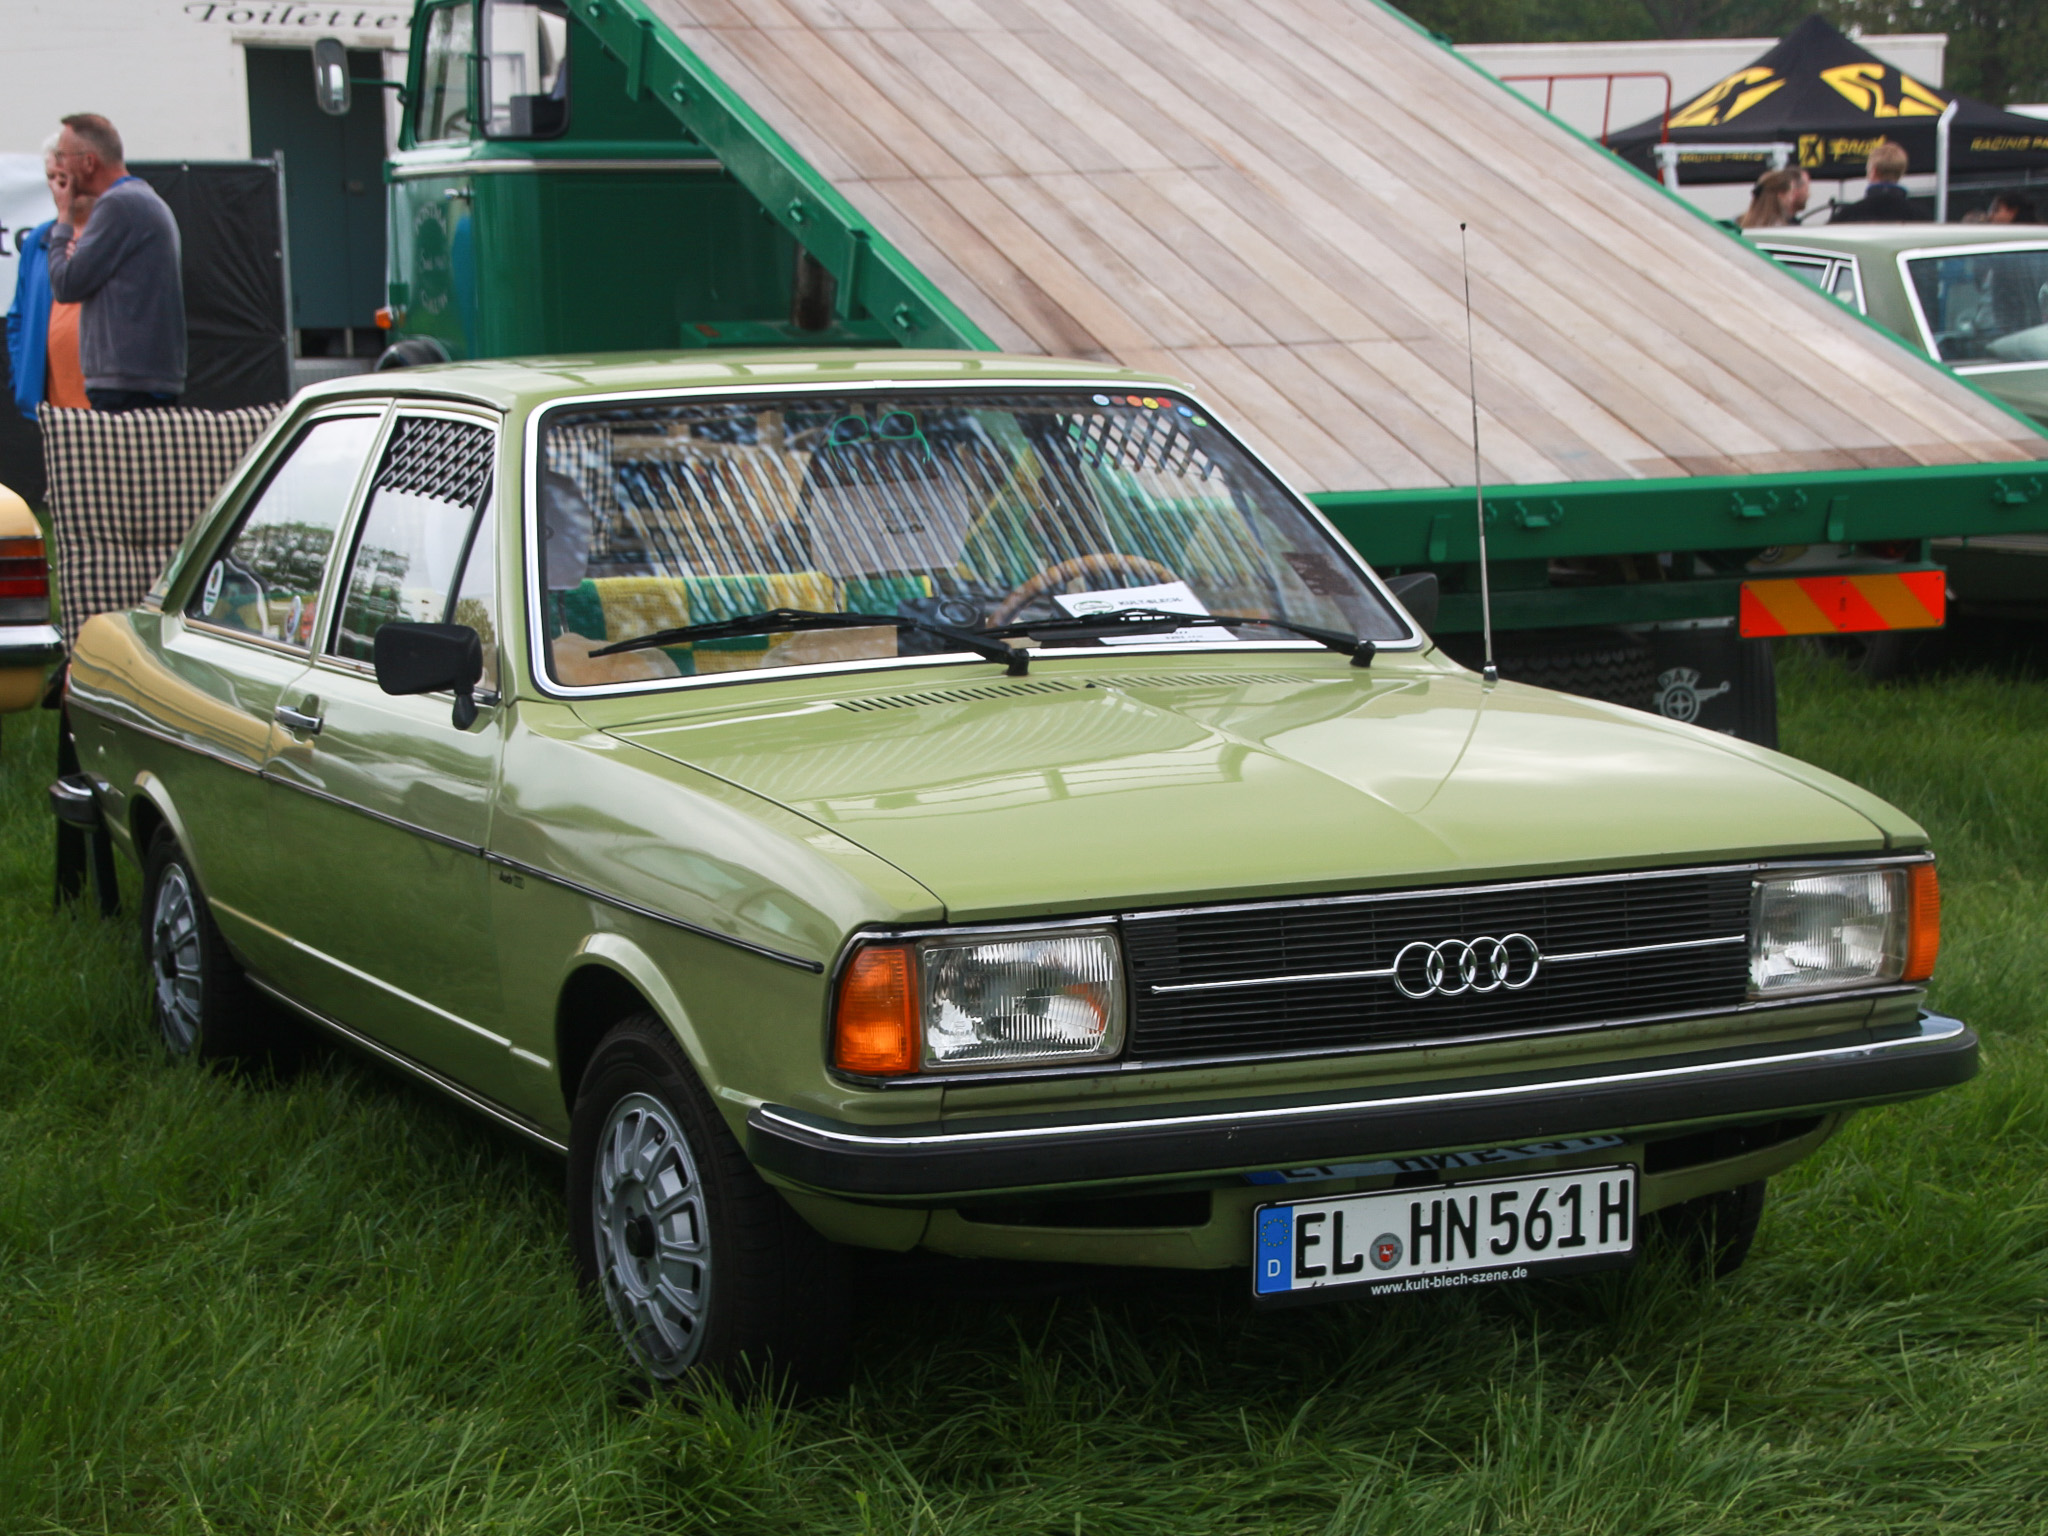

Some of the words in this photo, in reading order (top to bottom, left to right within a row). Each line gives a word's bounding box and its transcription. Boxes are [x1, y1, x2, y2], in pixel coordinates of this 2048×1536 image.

[1295, 1210, 1364, 1280] EL
[1267, 1258, 1281, 1278] D
[1370, 1266, 1528, 1297] www.kult-blech-szene.de
